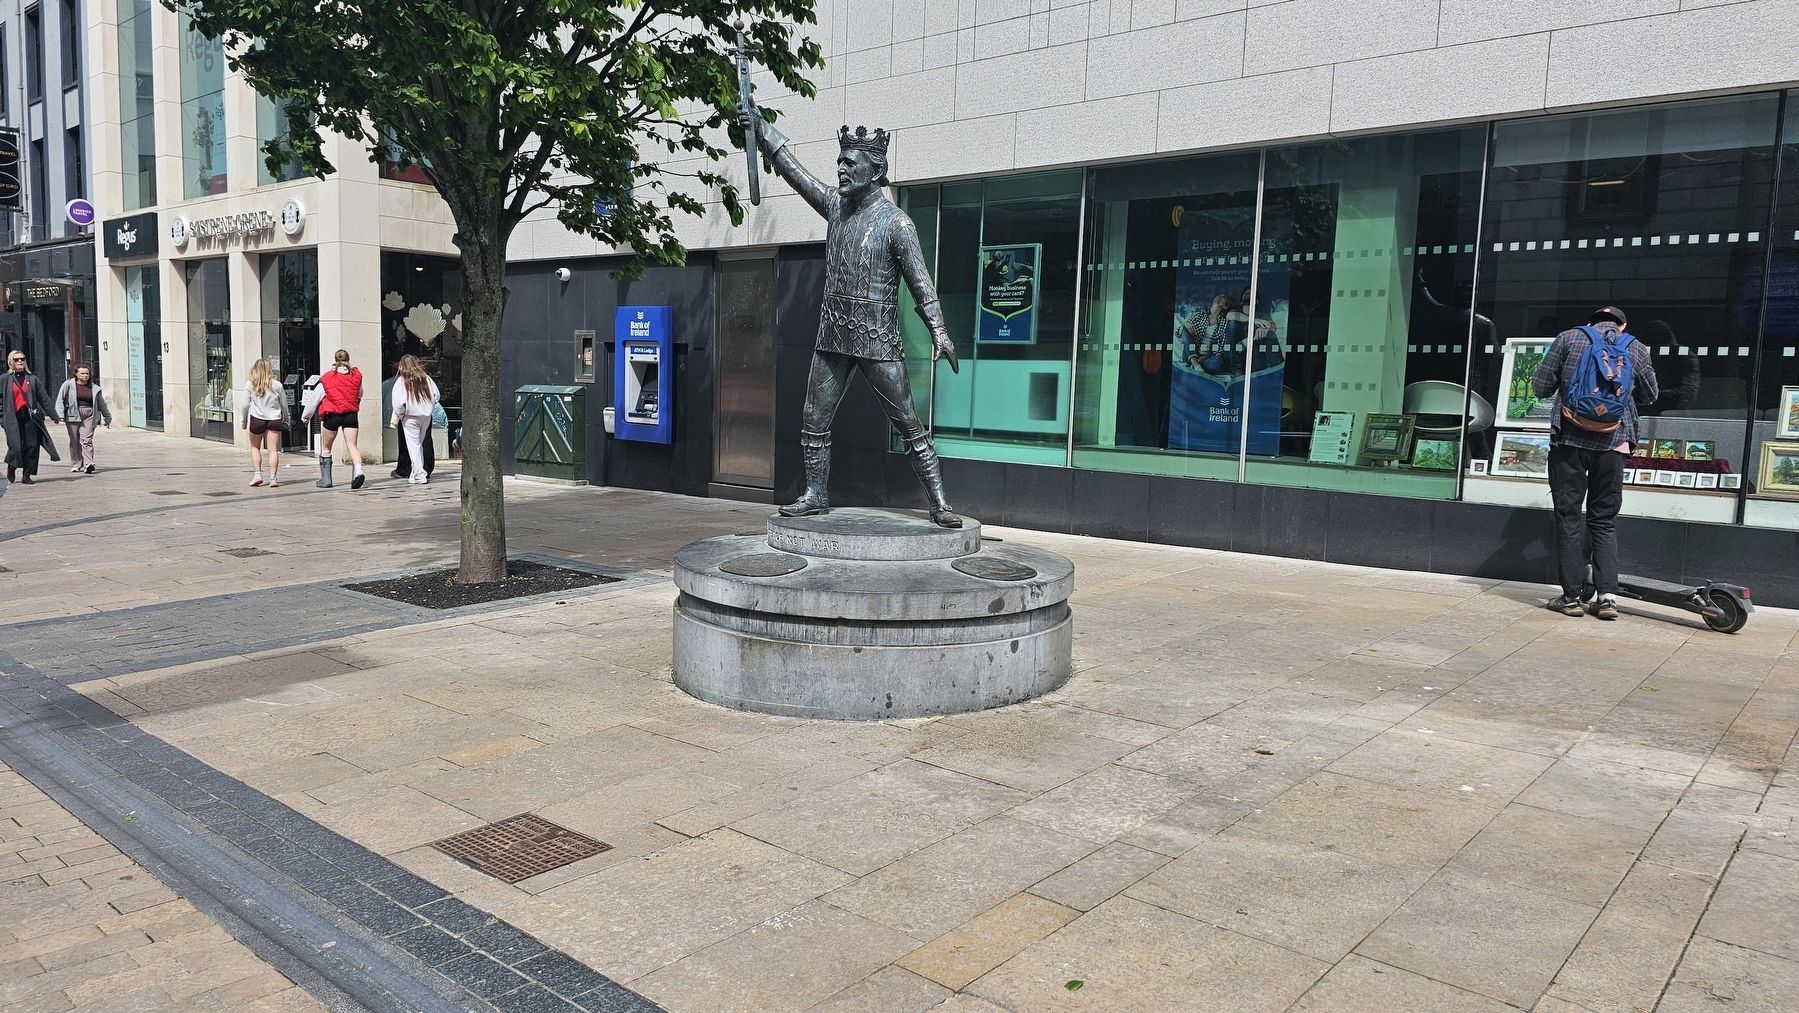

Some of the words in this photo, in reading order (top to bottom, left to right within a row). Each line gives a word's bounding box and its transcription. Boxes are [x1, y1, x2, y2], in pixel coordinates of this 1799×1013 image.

[186, 28, 223, 73] Regu
[117, 229, 137, 251] Regus
[1234, 238, 1276, 249] mong
[27, 288, 36, 299] THE
[37, 286, 60, 298] BEDFORD
[630, 321, 644, 329] Bank
[644, 321, 650, 329] of
[630, 328, 649, 336] Ireland
[103, 341, 108, 351] 13
[163, 342, 169, 353] 13
[1209, 406, 1230, 415] Bank
[1230, 407, 1240, 415] of
[1209, 414, 1238, 422] Ireland
[786, 534, 805, 547] NOT
[811, 538, 840, 551] WAR
